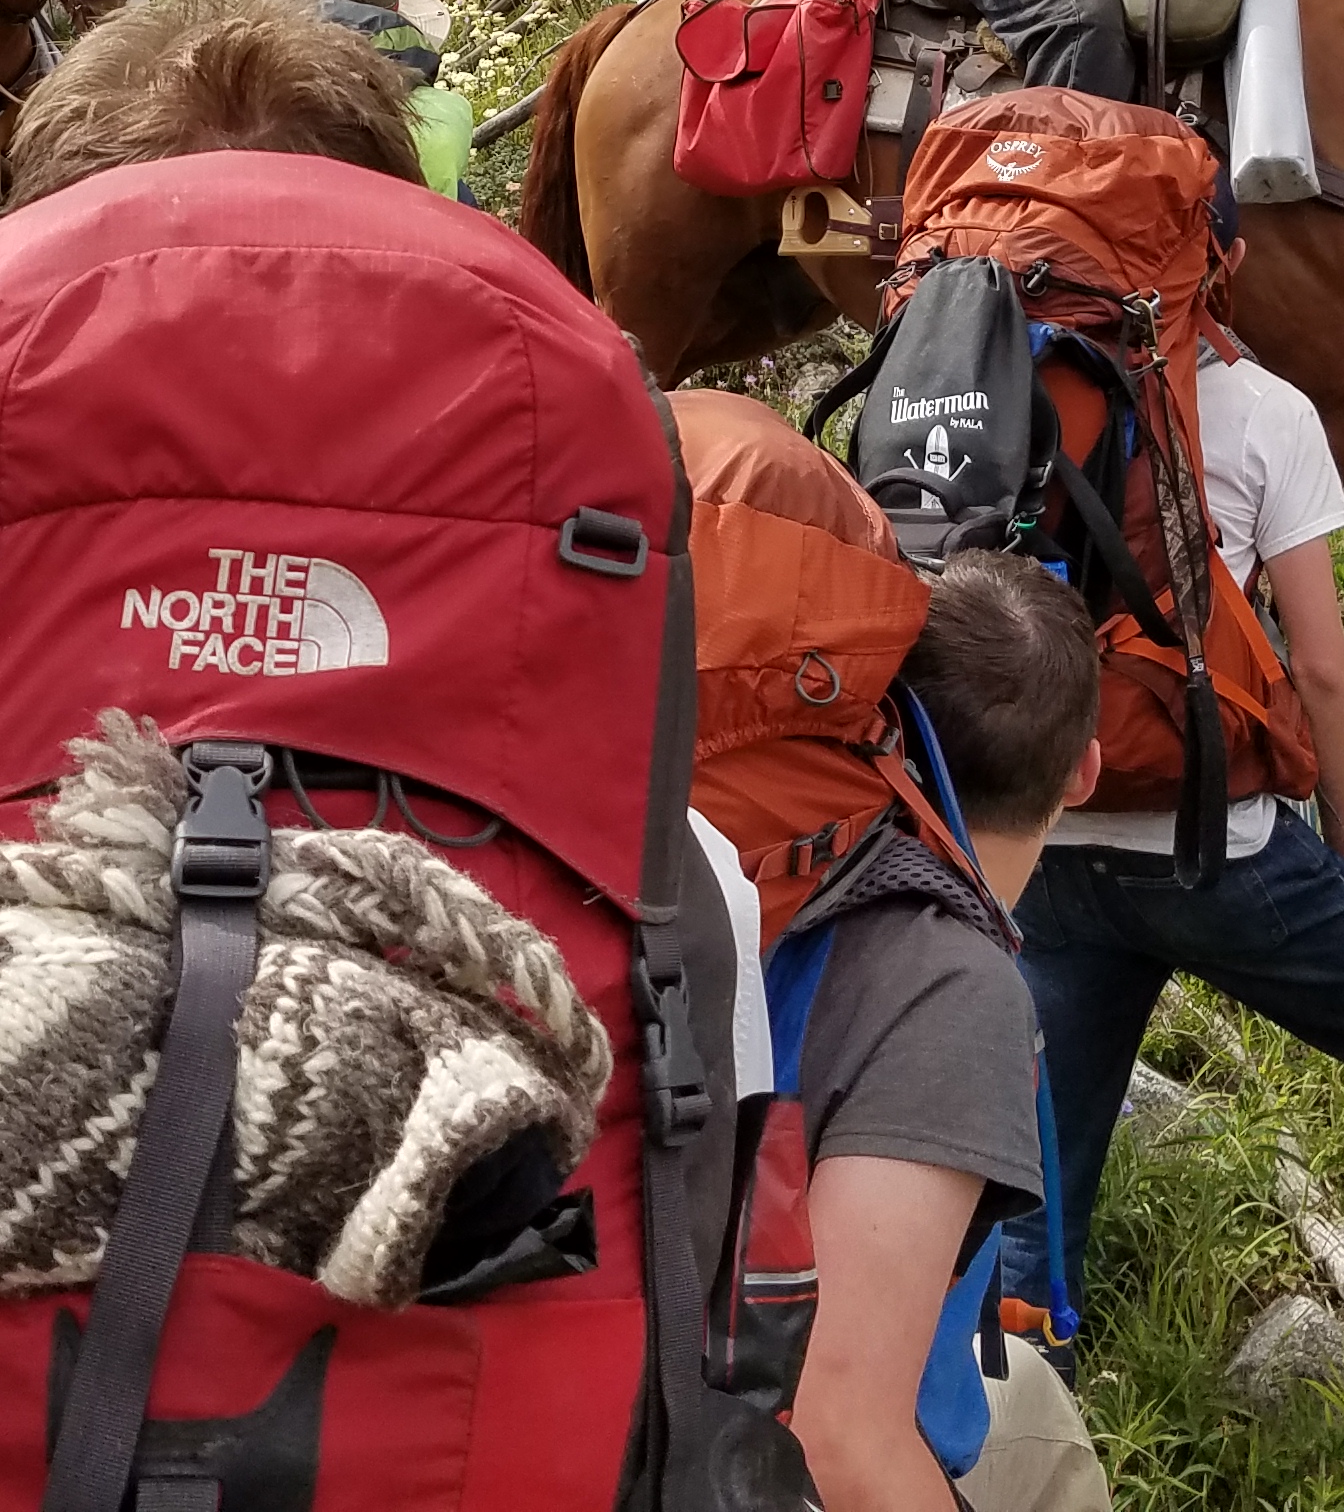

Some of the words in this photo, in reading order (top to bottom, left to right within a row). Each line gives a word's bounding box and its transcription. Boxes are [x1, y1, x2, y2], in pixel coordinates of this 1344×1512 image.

[990, 140, 1047, 158] OSPREY
[891, 391, 989, 423] Waterman
[949, 416, 959, 429] by
[959, 418, 983, 429] KALA
[208, 548, 310, 597] THE
[120, 585, 303, 639] NORTH
[168, 630, 299, 676] FACE
